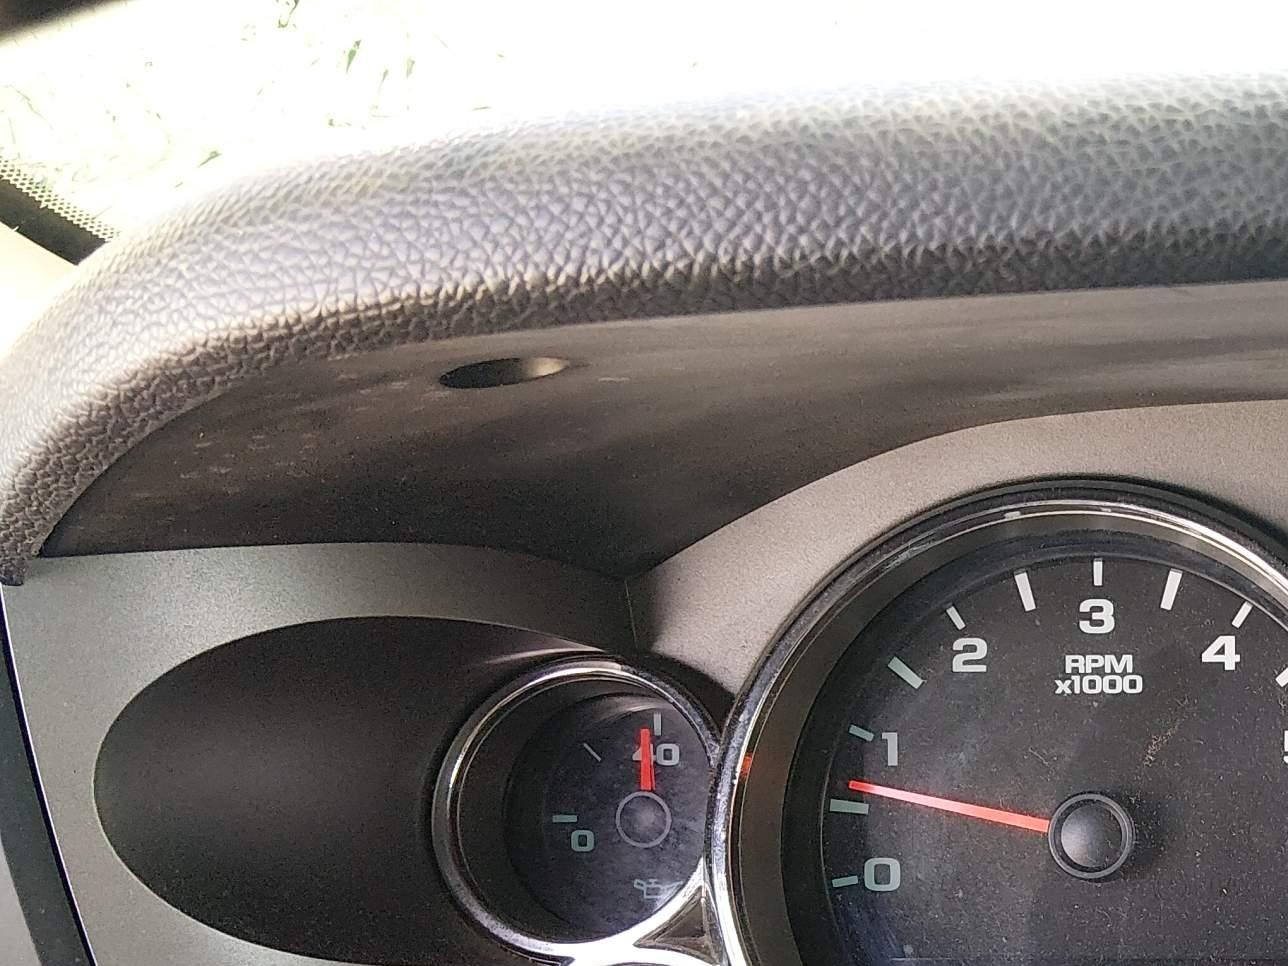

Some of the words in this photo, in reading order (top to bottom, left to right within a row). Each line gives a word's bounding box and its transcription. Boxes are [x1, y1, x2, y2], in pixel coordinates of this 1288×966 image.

[1080, 599, 1114, 633] 3
[953, 638, 987, 672] 2
[1065, 655, 1133, 674] RPM
[1202, 636, 1240, 670] 4
[1055, 675, 1143, 694] x1000
[881, 732, 899, 766] 1
[571, 830, 595, 852] 0
[865, 857, 901, 892] 0
